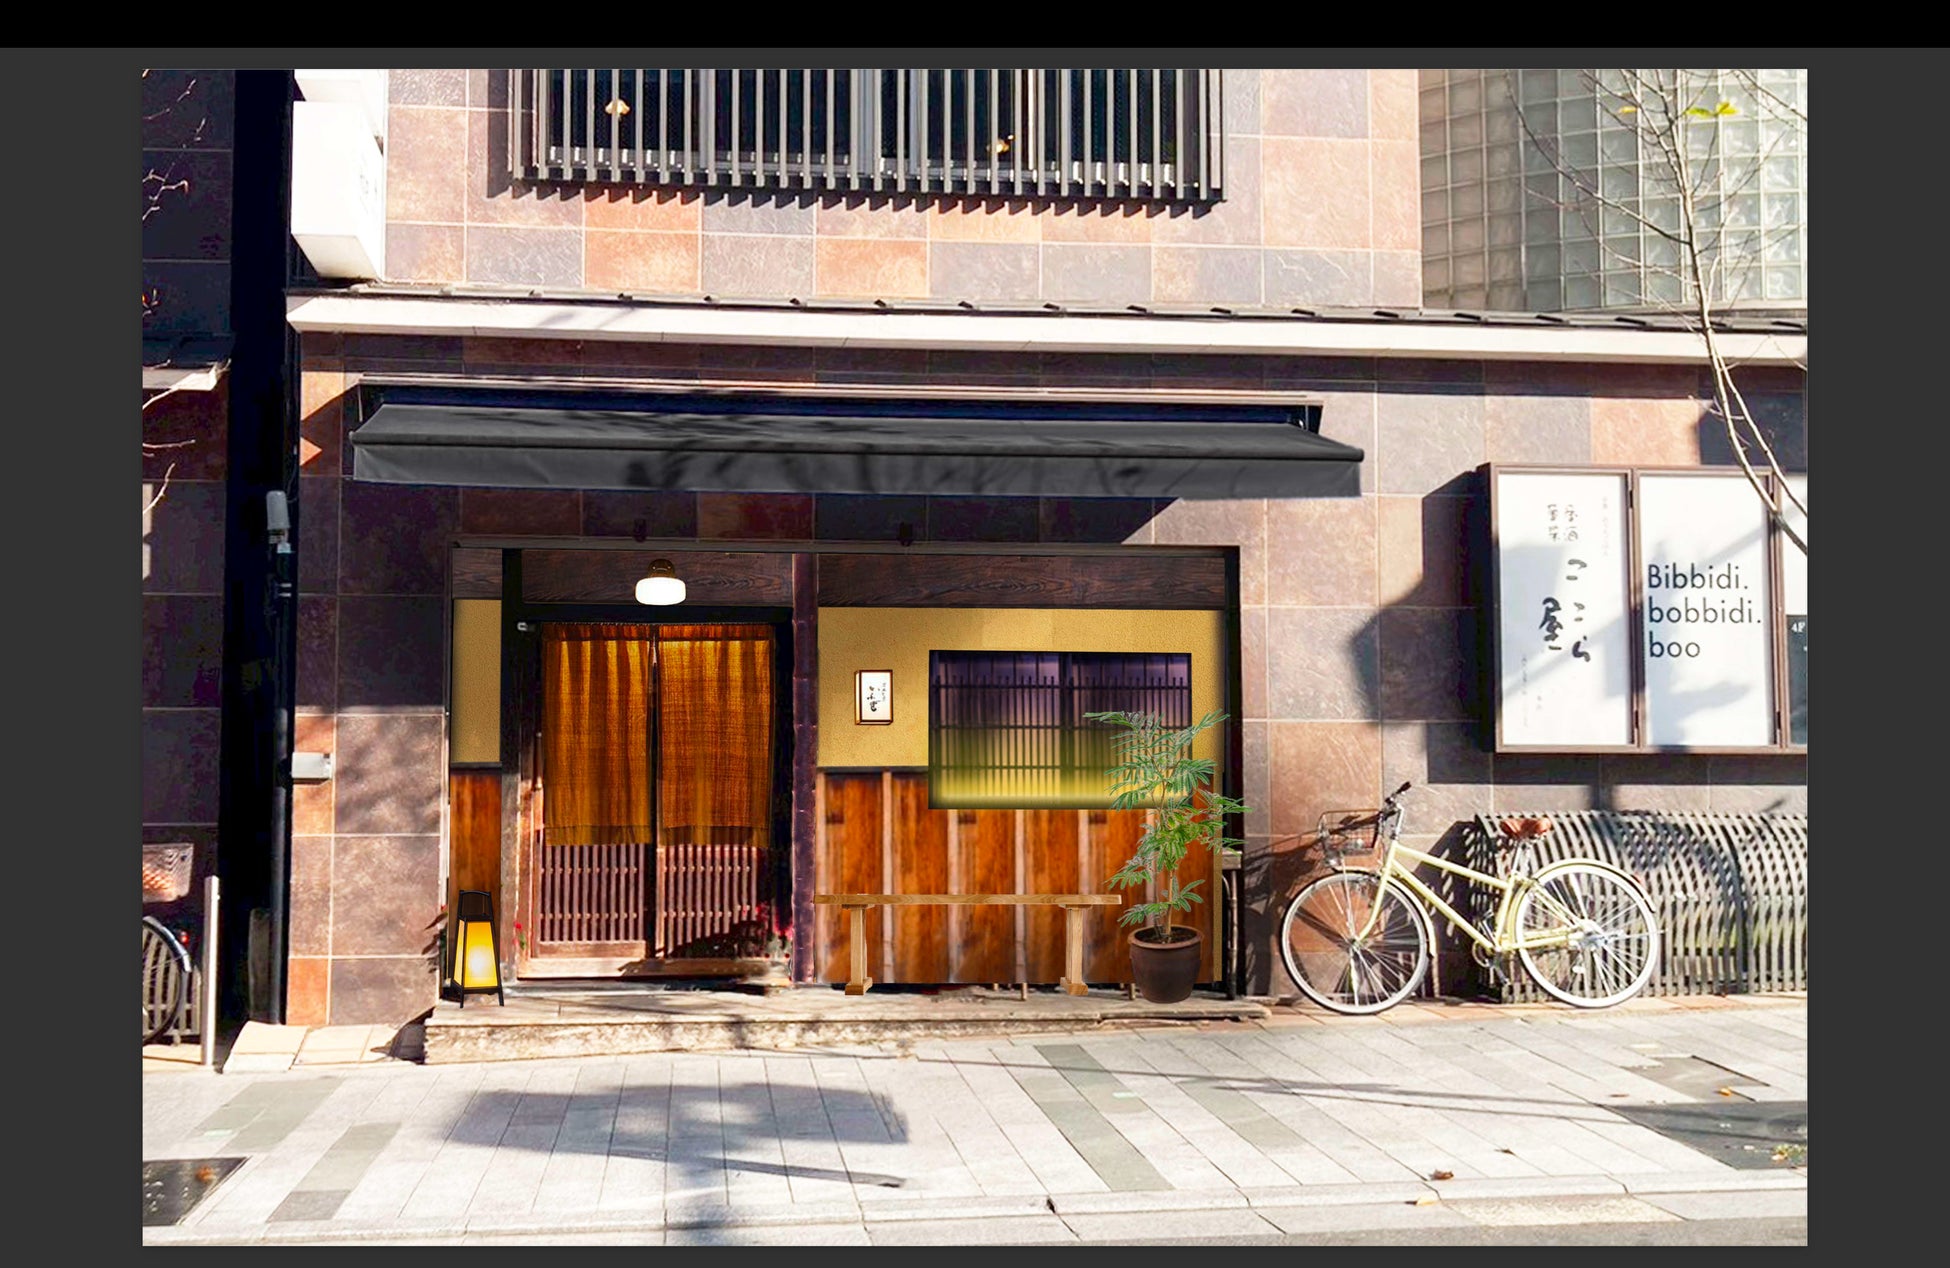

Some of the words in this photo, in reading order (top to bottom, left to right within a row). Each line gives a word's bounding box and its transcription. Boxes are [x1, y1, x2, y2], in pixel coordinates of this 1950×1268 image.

[1647, 561, 1749, 590] Bibbidi.
[1648, 595, 1762, 624] bobbidi.
[1649, 630, 1701, 658] boo
